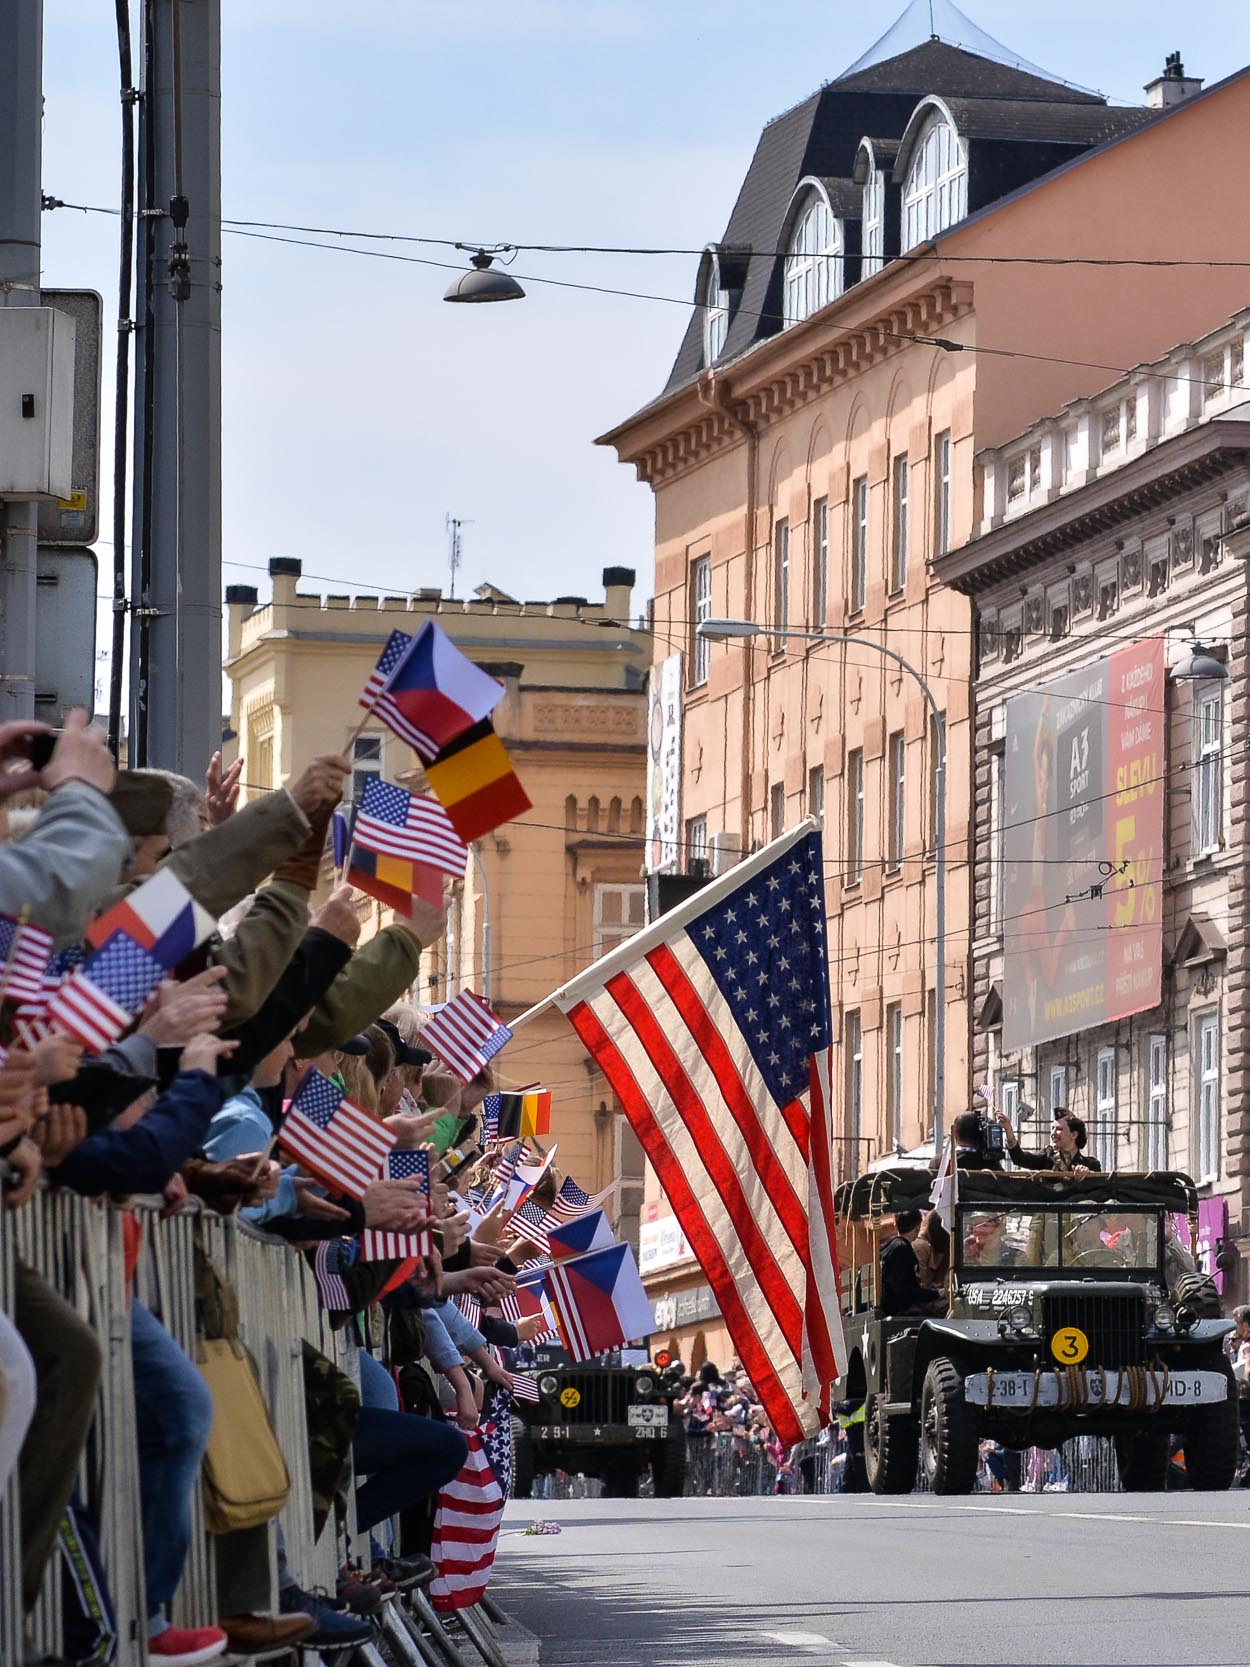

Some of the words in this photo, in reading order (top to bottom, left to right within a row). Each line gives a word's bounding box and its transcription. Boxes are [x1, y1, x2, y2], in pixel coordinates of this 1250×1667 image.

[1070, 726, 1089, 780] A3
[1115, 752, 1157, 807] SLEVU
[968, 1288, 984, 1305] USA
[1061, 1335, 1080, 1358] 3
[1164, 1380, 1203, 1397] MD-8
